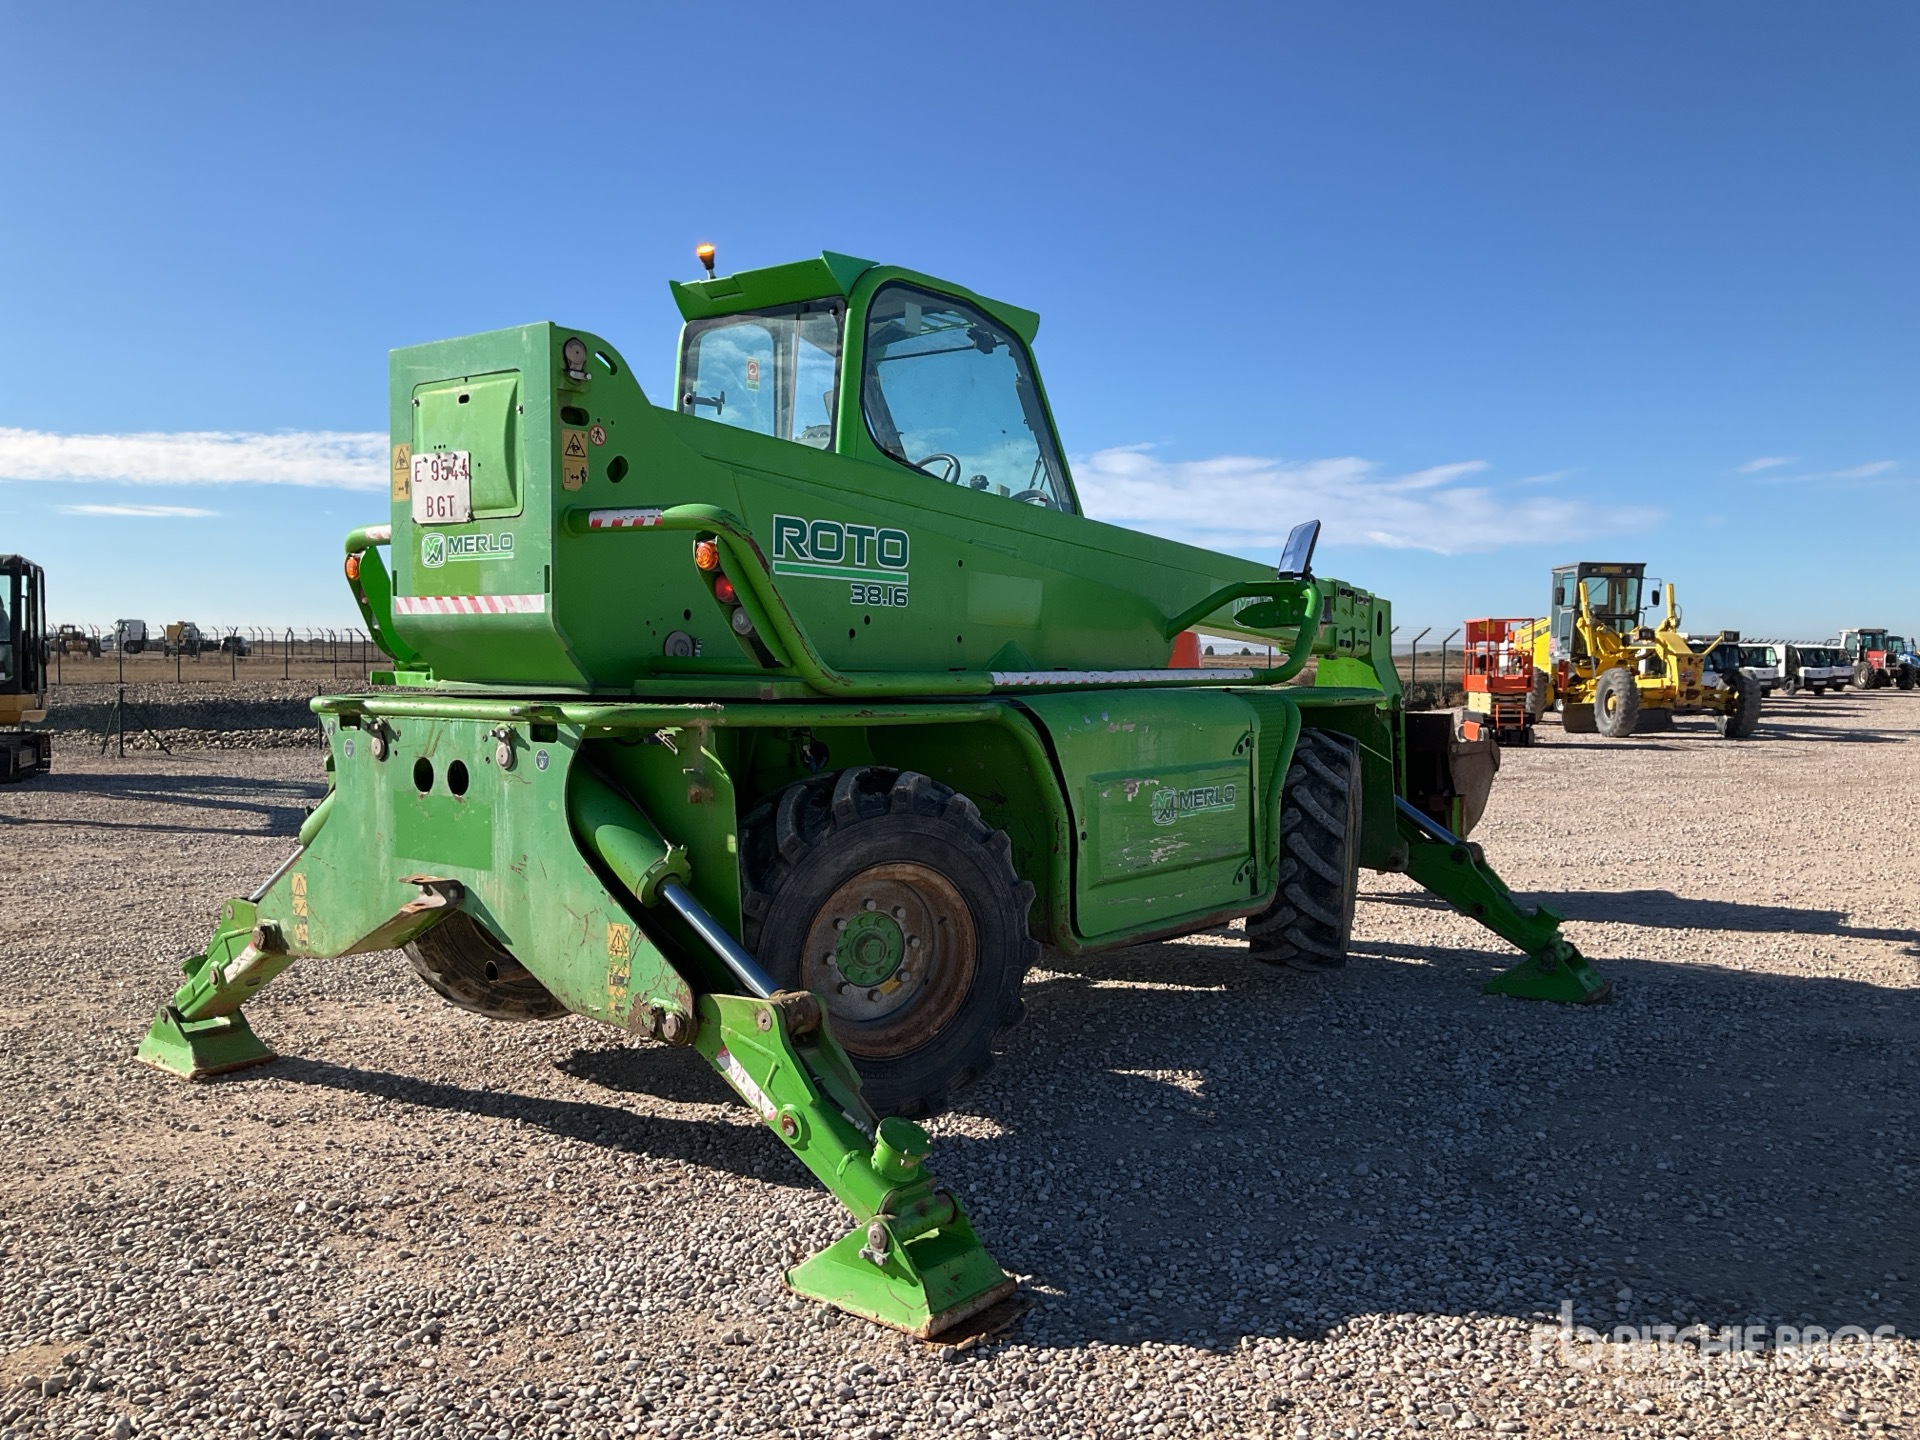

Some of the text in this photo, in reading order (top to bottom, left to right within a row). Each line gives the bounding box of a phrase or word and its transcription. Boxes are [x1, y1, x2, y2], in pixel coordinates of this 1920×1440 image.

[414, 461, 423, 482] E
[426, 494, 455, 518] BGT
[447, 533, 515, 555] MERLO
[773, 514, 910, 570] ROTO
[850, 584, 909, 607] 38.16
[1178, 784, 1236, 811] MERLO
